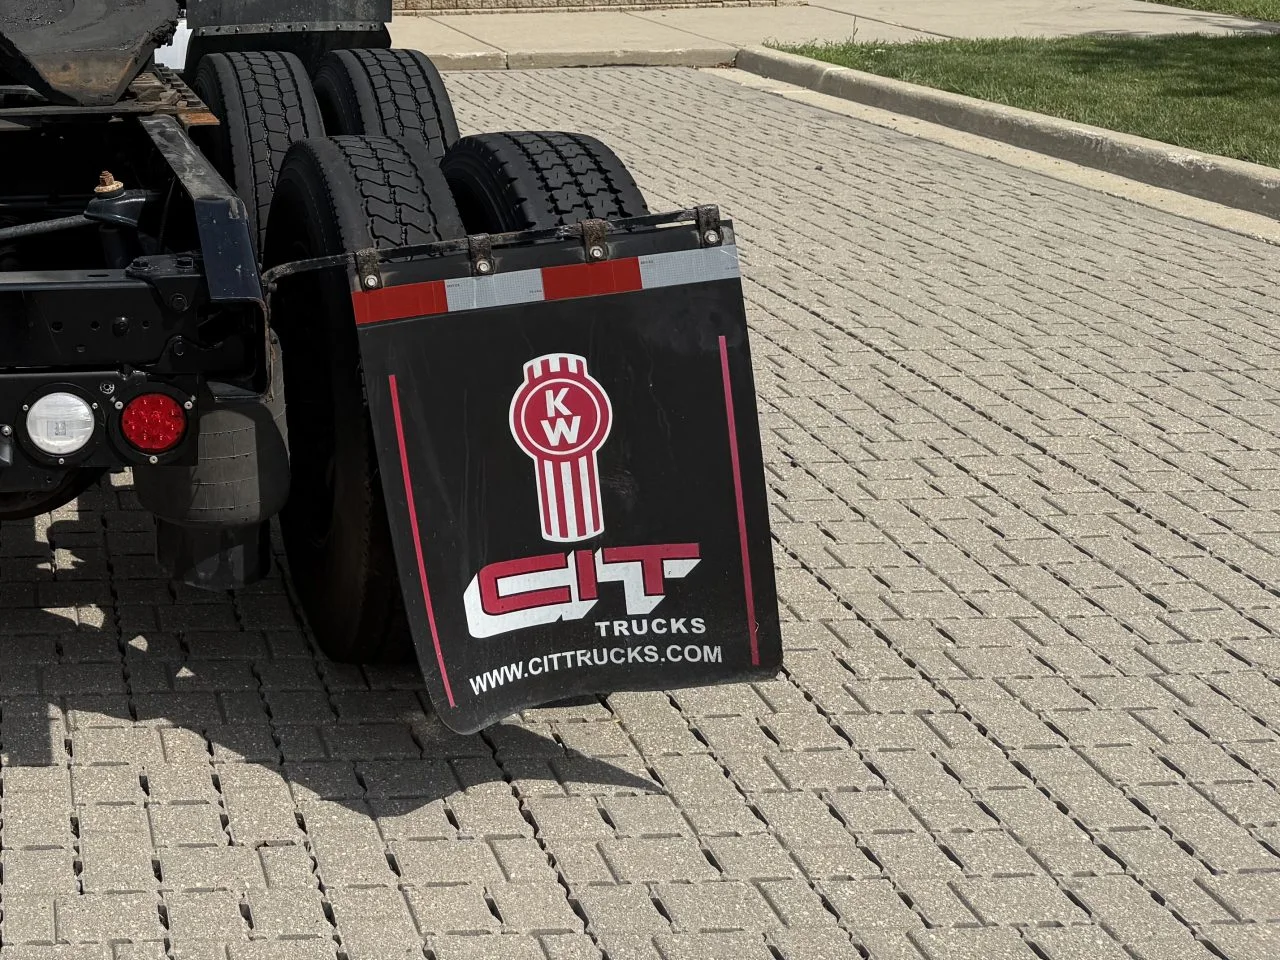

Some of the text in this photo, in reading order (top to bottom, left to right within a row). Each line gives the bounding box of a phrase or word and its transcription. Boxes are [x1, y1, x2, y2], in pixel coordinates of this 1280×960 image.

[546, 387, 574, 417] K
[540, 415, 581, 447] W
[463, 543, 702, 638] CIT
[594, 617, 707, 638] TRUCKS
[469, 645, 723, 696] WWW.CITTRUCKS.COM
